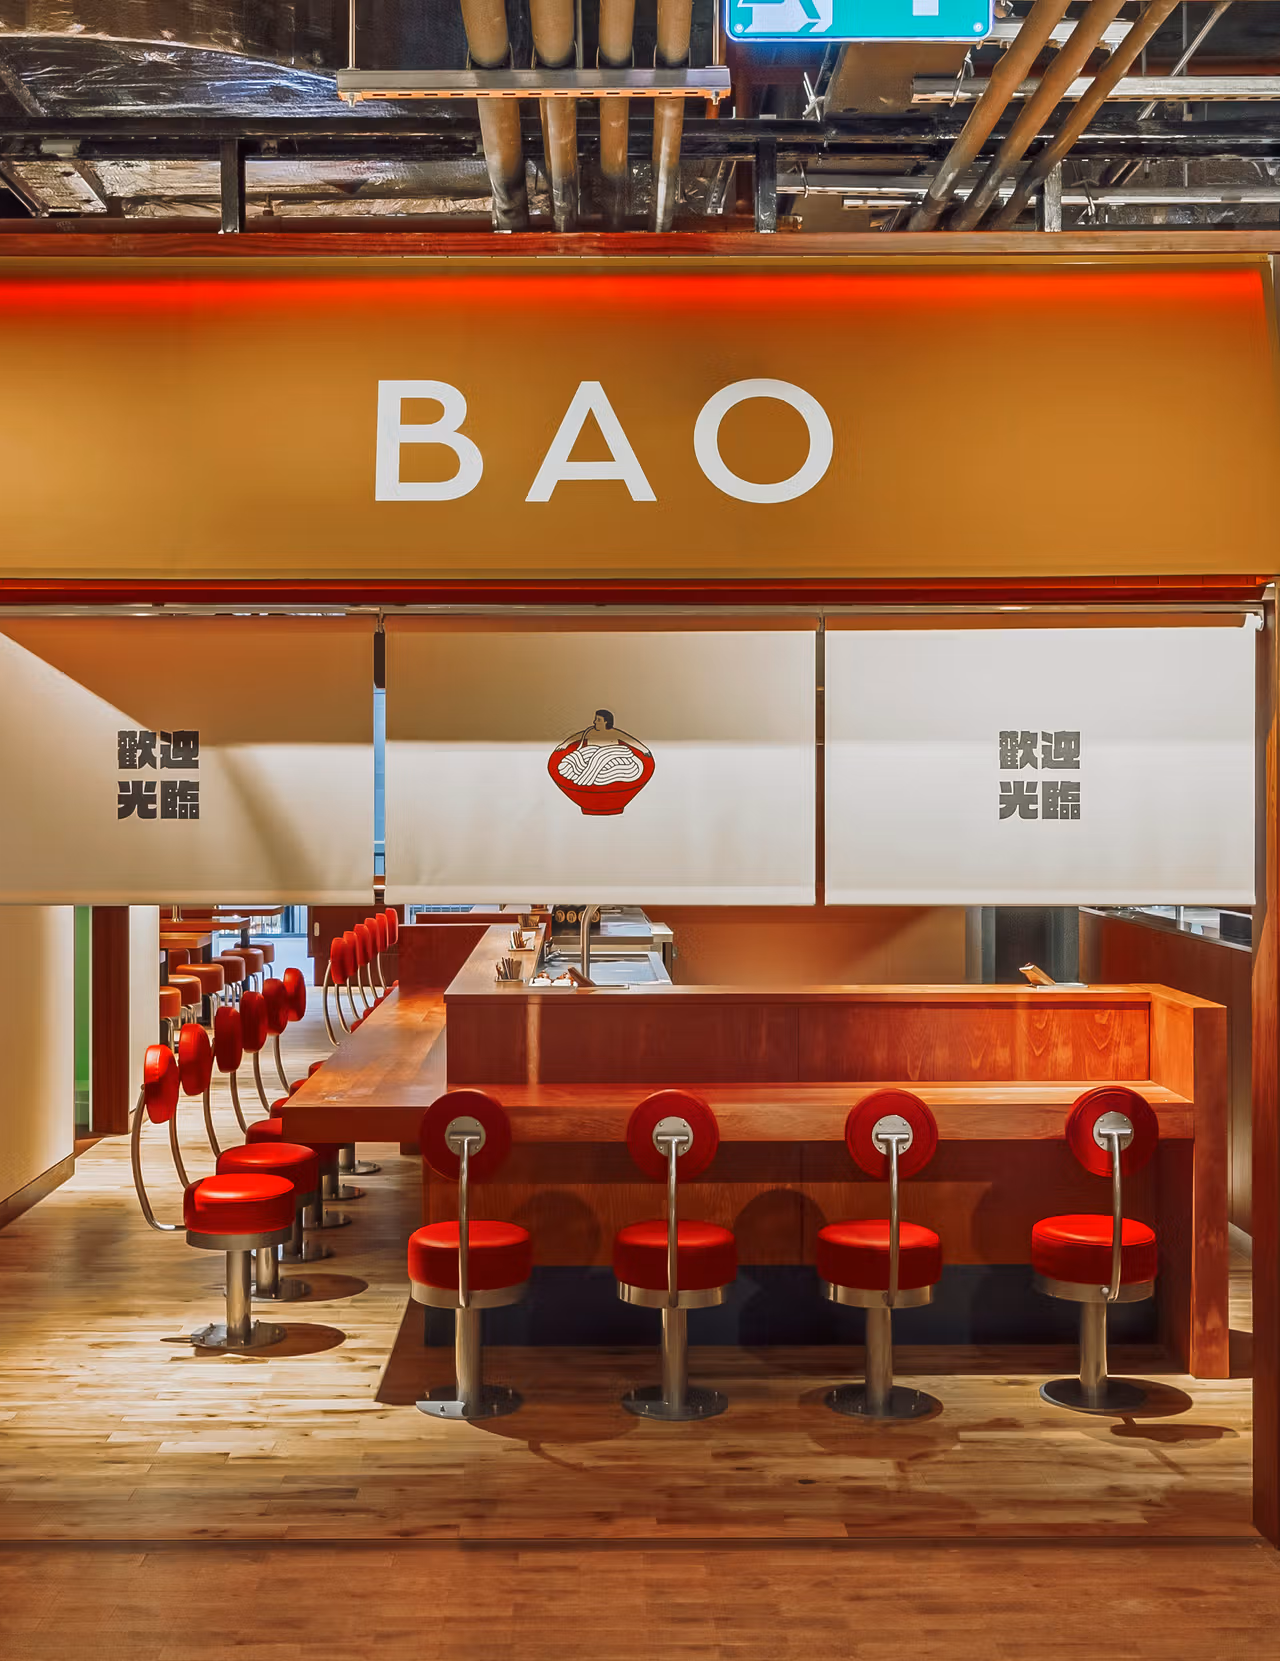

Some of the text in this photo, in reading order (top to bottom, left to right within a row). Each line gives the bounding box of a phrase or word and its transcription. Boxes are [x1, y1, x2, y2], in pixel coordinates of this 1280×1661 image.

[374, 377, 834, 504] BAO
[117, 730, 200, 770] 歡迎
[998, 730, 1081, 770] 歡迎
[117, 780, 200, 820] 光臨
[998, 780, 1081, 820] 光臨
